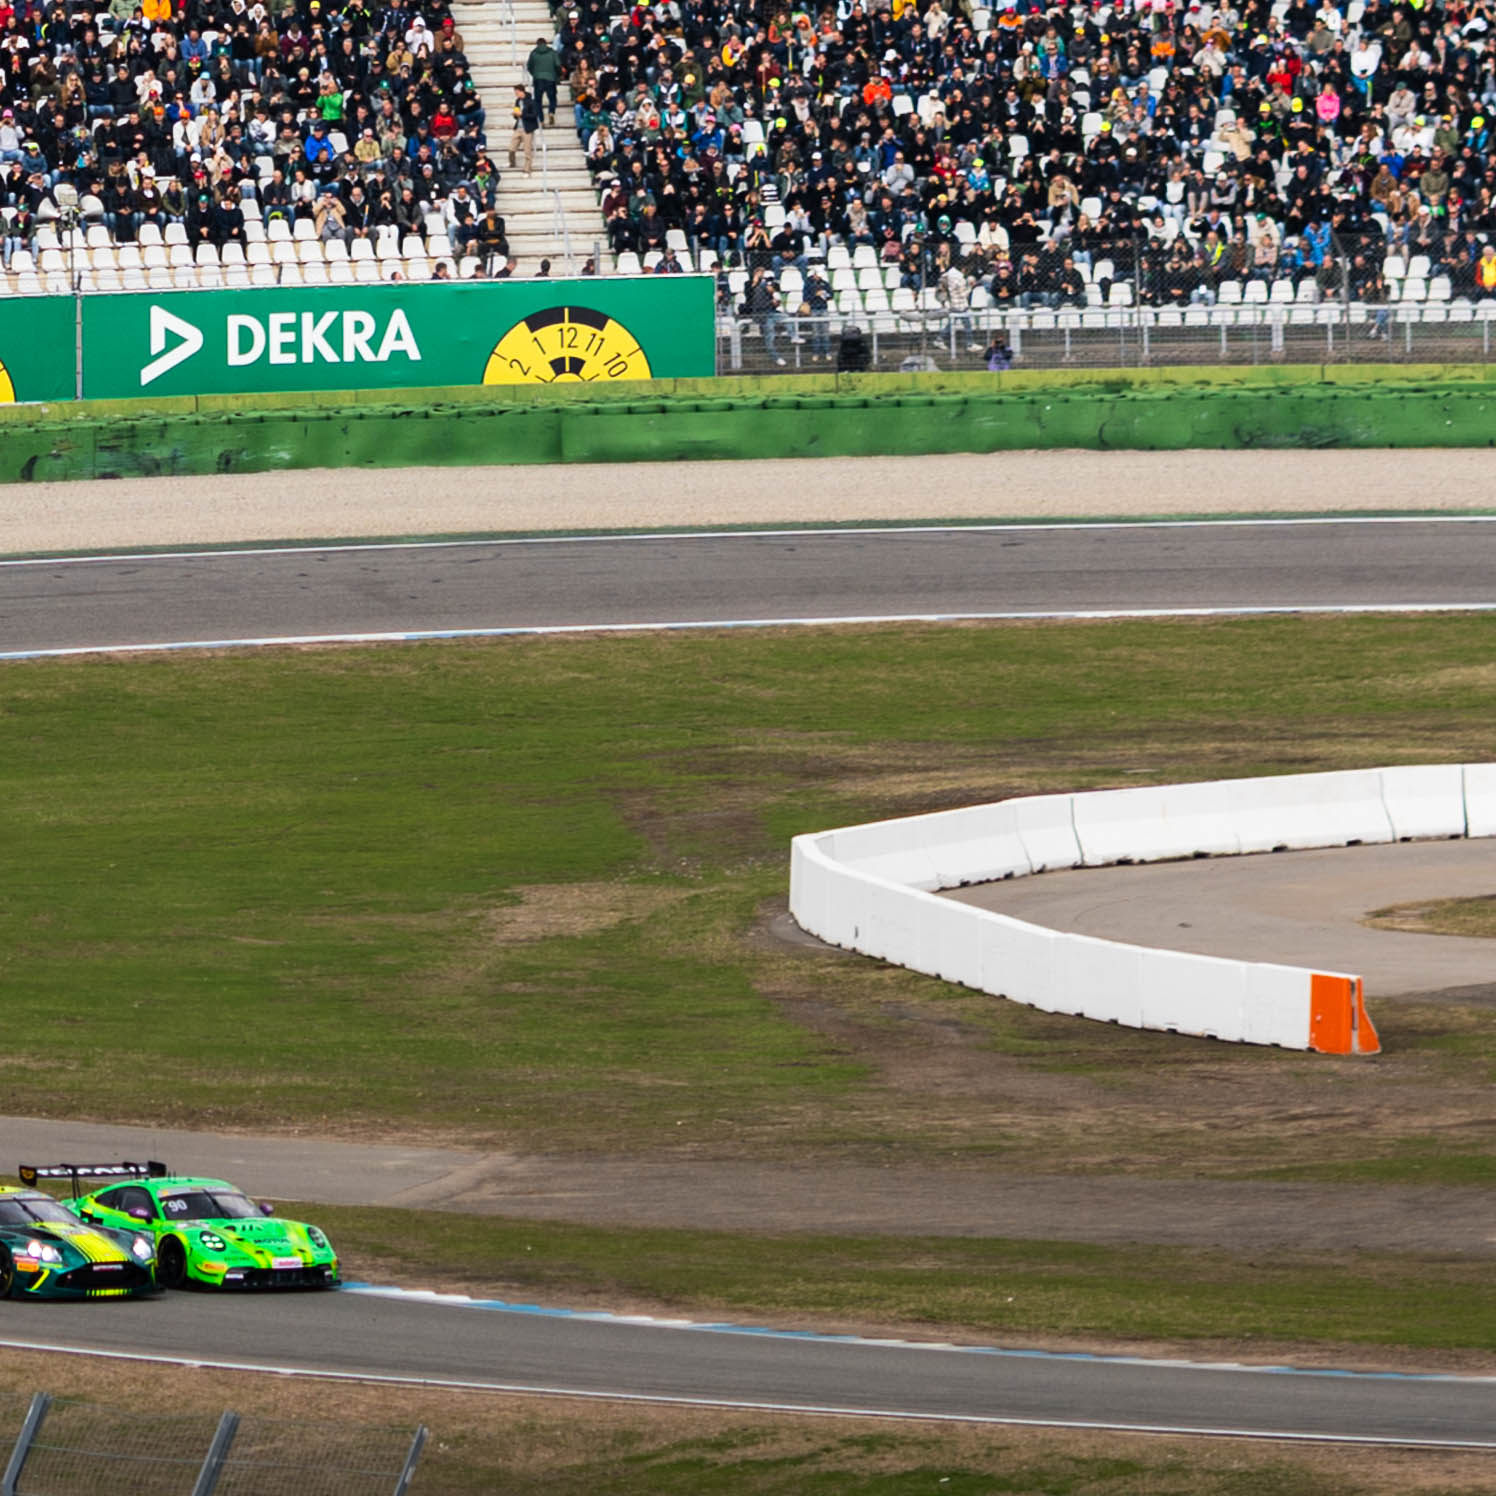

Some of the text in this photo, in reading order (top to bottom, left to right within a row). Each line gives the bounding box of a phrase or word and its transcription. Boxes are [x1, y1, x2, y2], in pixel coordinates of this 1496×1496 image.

[228, 309, 421, 366] DEKRA
[509, 327, 629, 378] 2 1 12 11 10
[167, 1199, 188, 1212] 90
